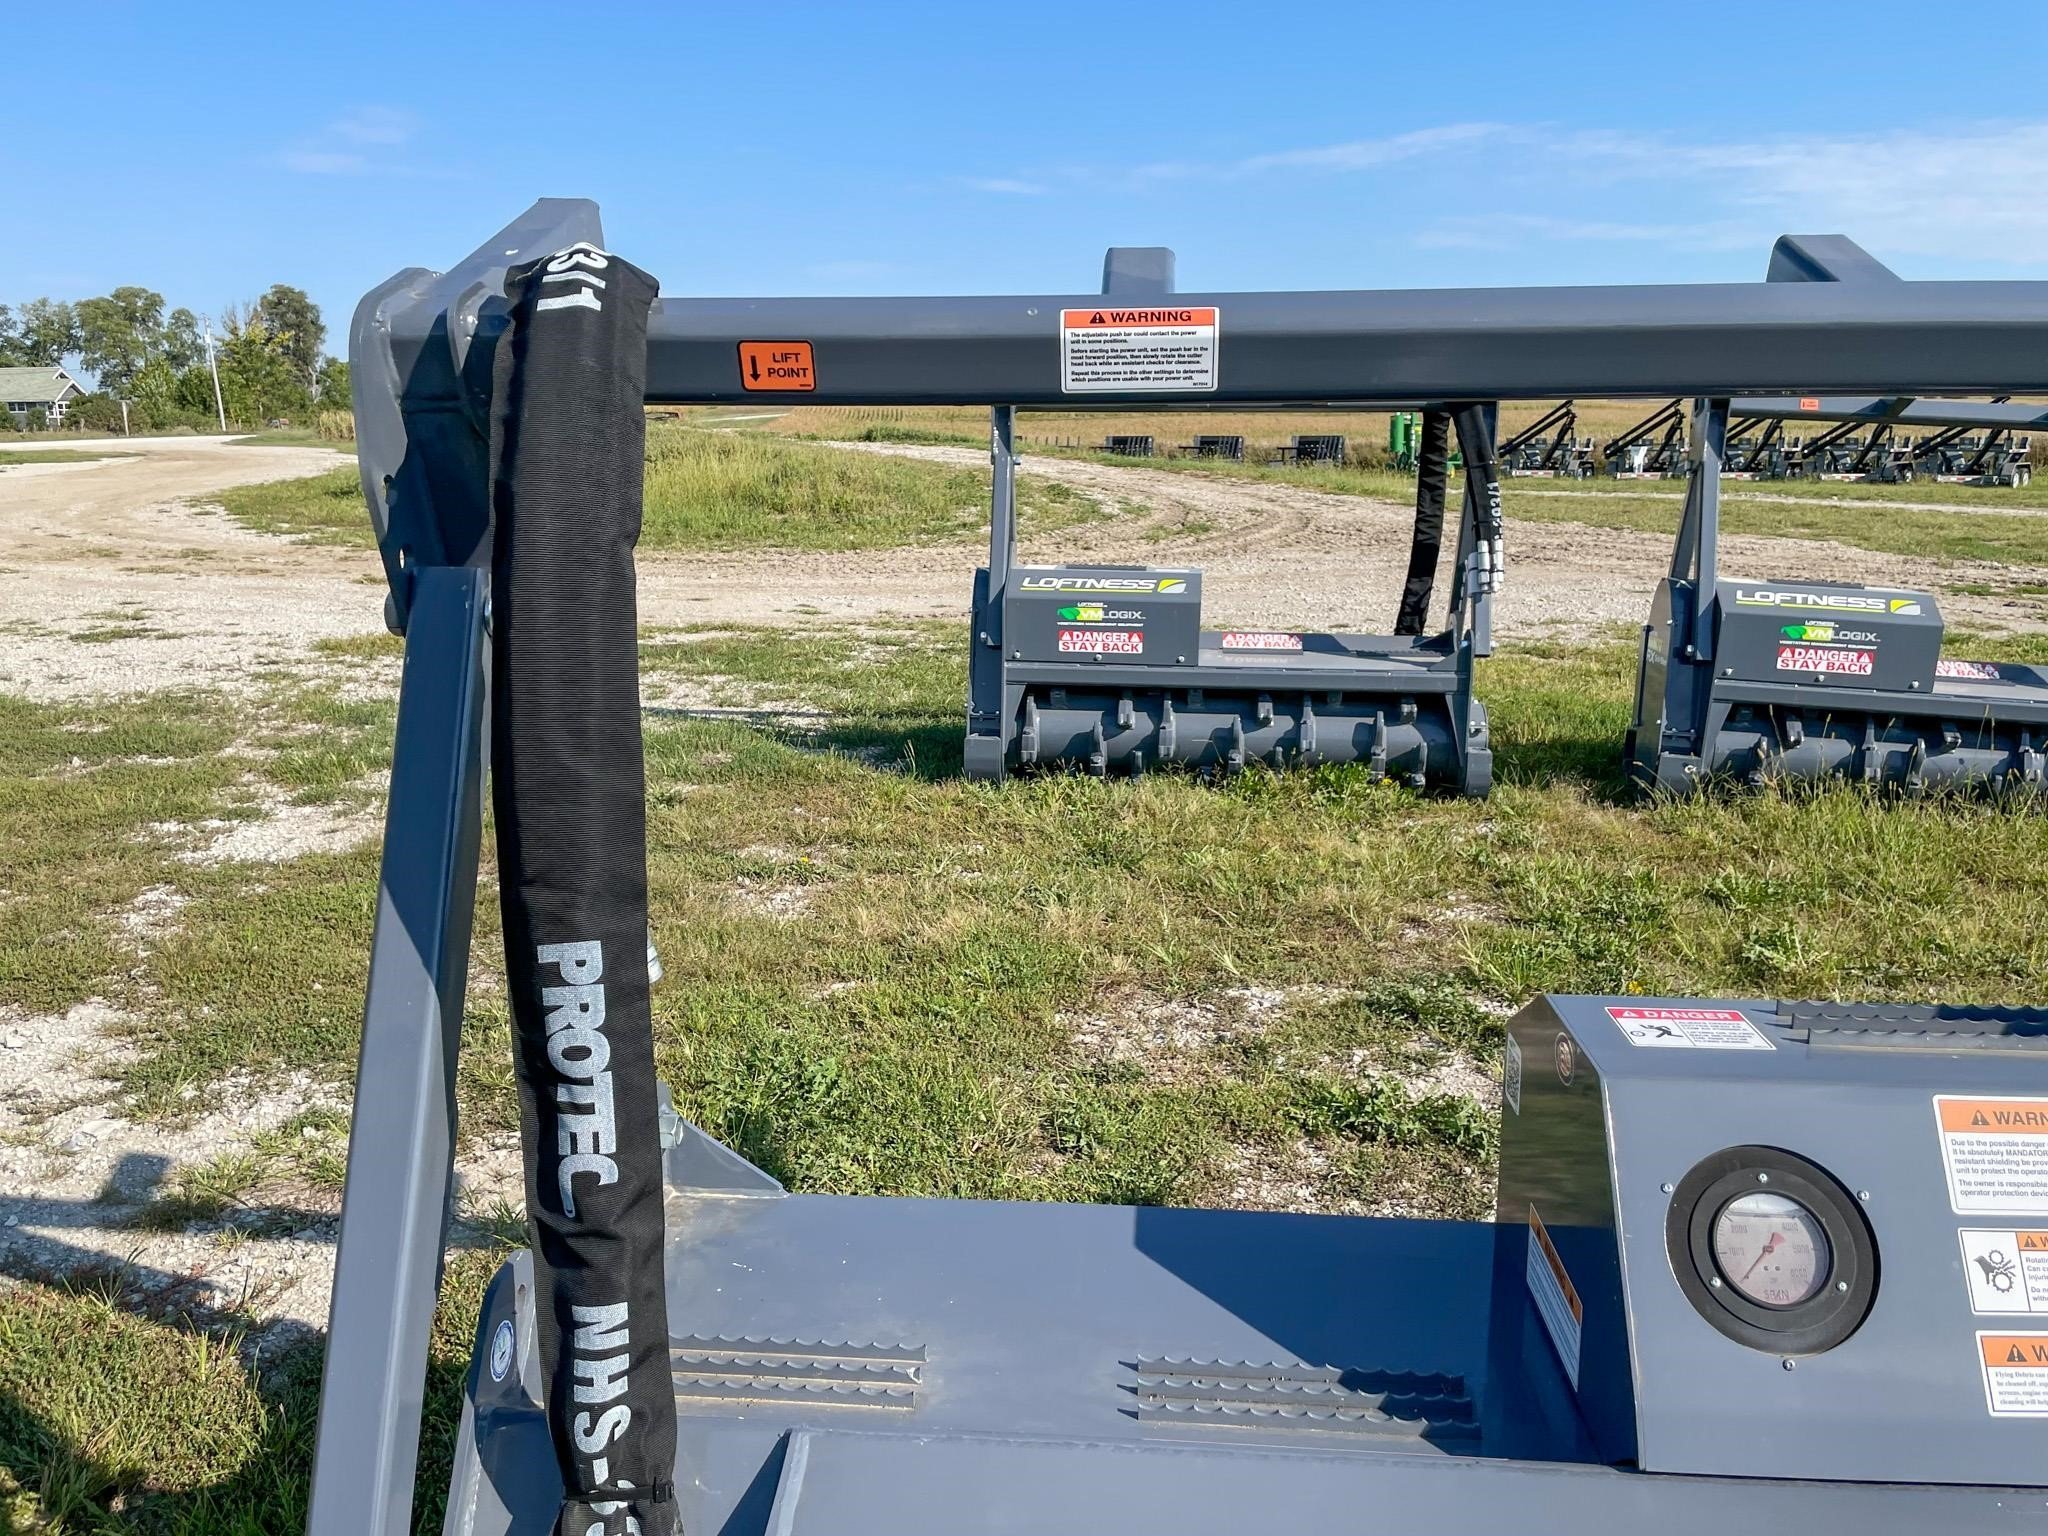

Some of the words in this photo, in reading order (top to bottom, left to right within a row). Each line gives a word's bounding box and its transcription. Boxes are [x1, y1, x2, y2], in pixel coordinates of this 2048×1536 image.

[1110, 310, 1192, 323] WARNING
[772, 352, 801, 363] LIFT
[767, 367, 808, 378] POINT
[1022, 577, 1158, 590] LOFTNESS
[1736, 590, 1886, 609] LOFTNESS
[1072, 631, 1129, 642] DANGER
[1236, 633, 1290, 641] DANGER
[1062, 642, 1098, 651] STAY
[1102, 642, 1139, 652] BACK
[1794, 648, 1858, 663] DANGER
[1781, 659, 1821, 670] STAY
[1826, 662, 1868, 673] BACK
[1644, 1011, 1732, 1020] DANGER
[537, 940, 619, 1219] PROTEC
[1989, 1140, 2019, 1148] possible
[2021, 1140, 2045, 1148] danger
[1967, 1149, 2004, 1157] absolutely
[1987, 1159, 2020, 1167] shielding
[2006, 1180, 2048, 1188] responsible
[1960, 1189, 1990, 1197] operator
